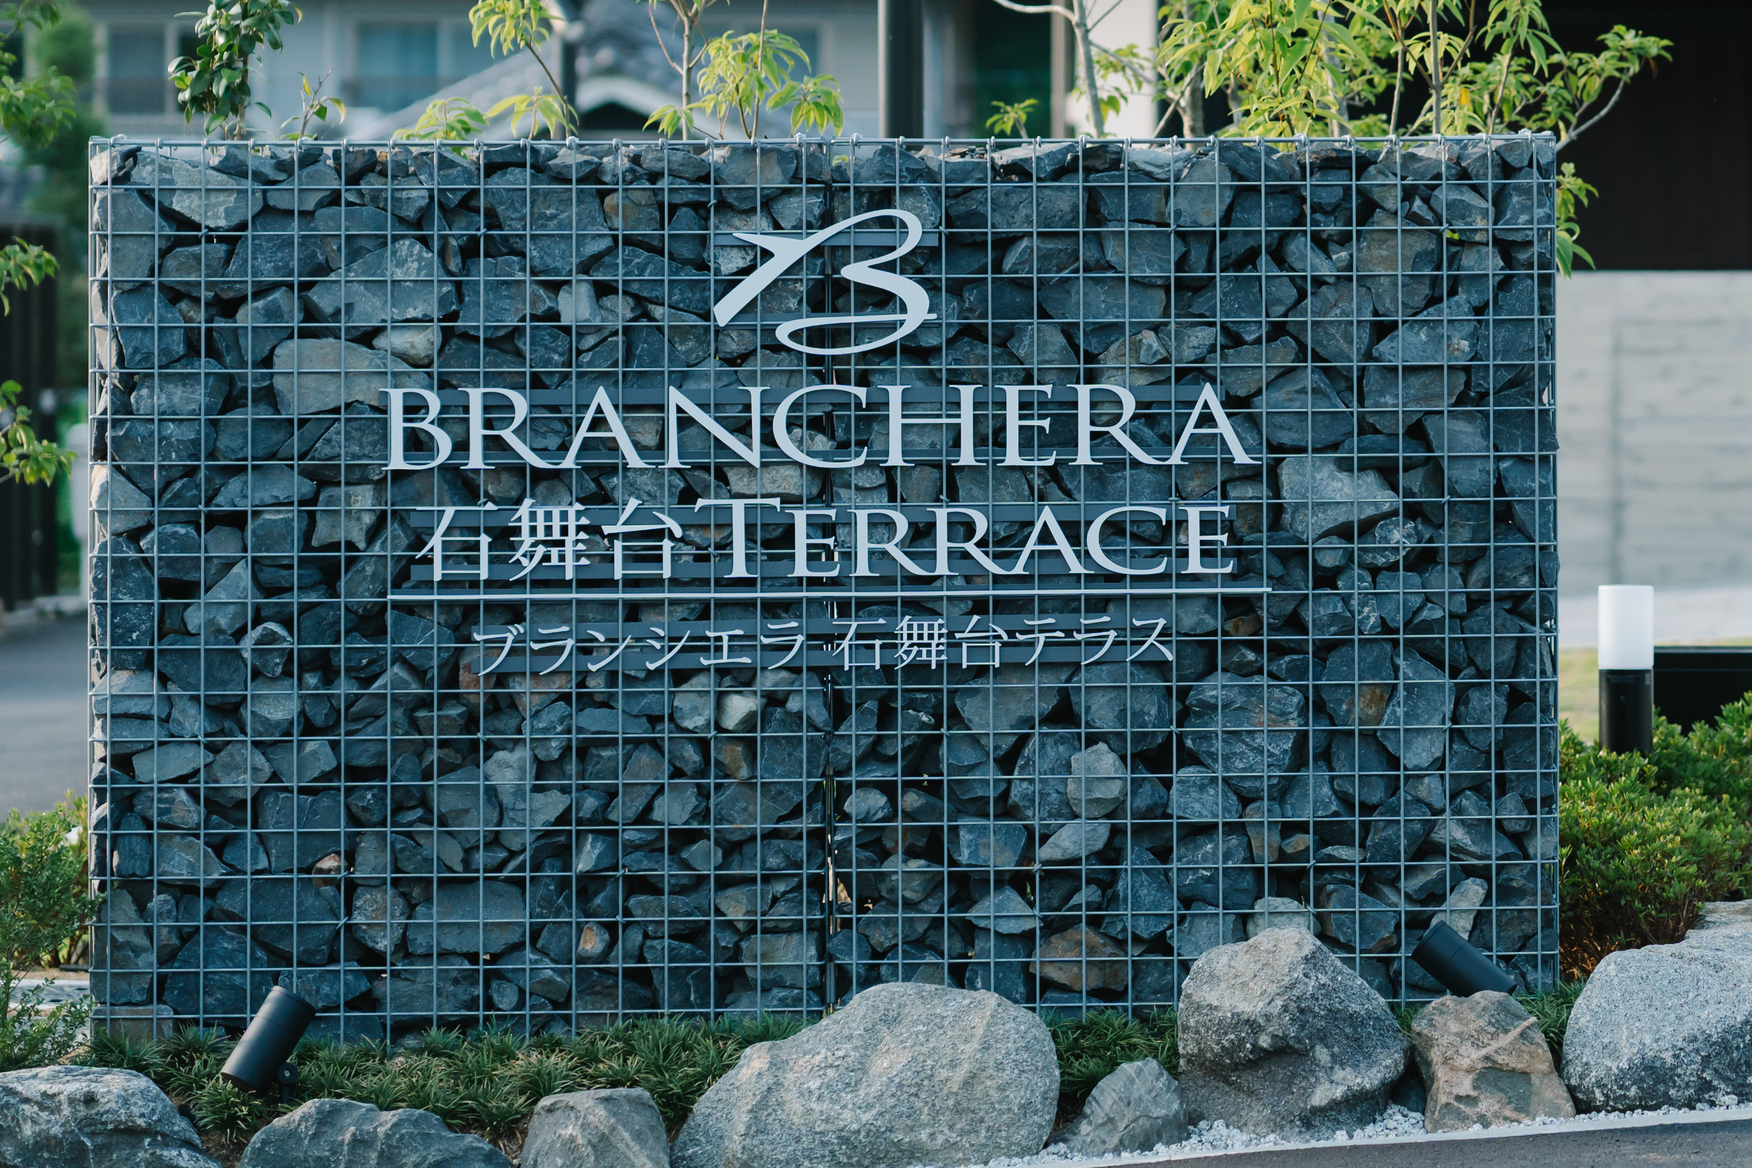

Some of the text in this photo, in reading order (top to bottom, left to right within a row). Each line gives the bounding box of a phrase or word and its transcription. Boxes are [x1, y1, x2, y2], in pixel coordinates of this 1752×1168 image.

[380, 383, 1262, 470] BRANCHERA
[473, 614, 1175, 676] ブランシエラ 石舞台テラス
